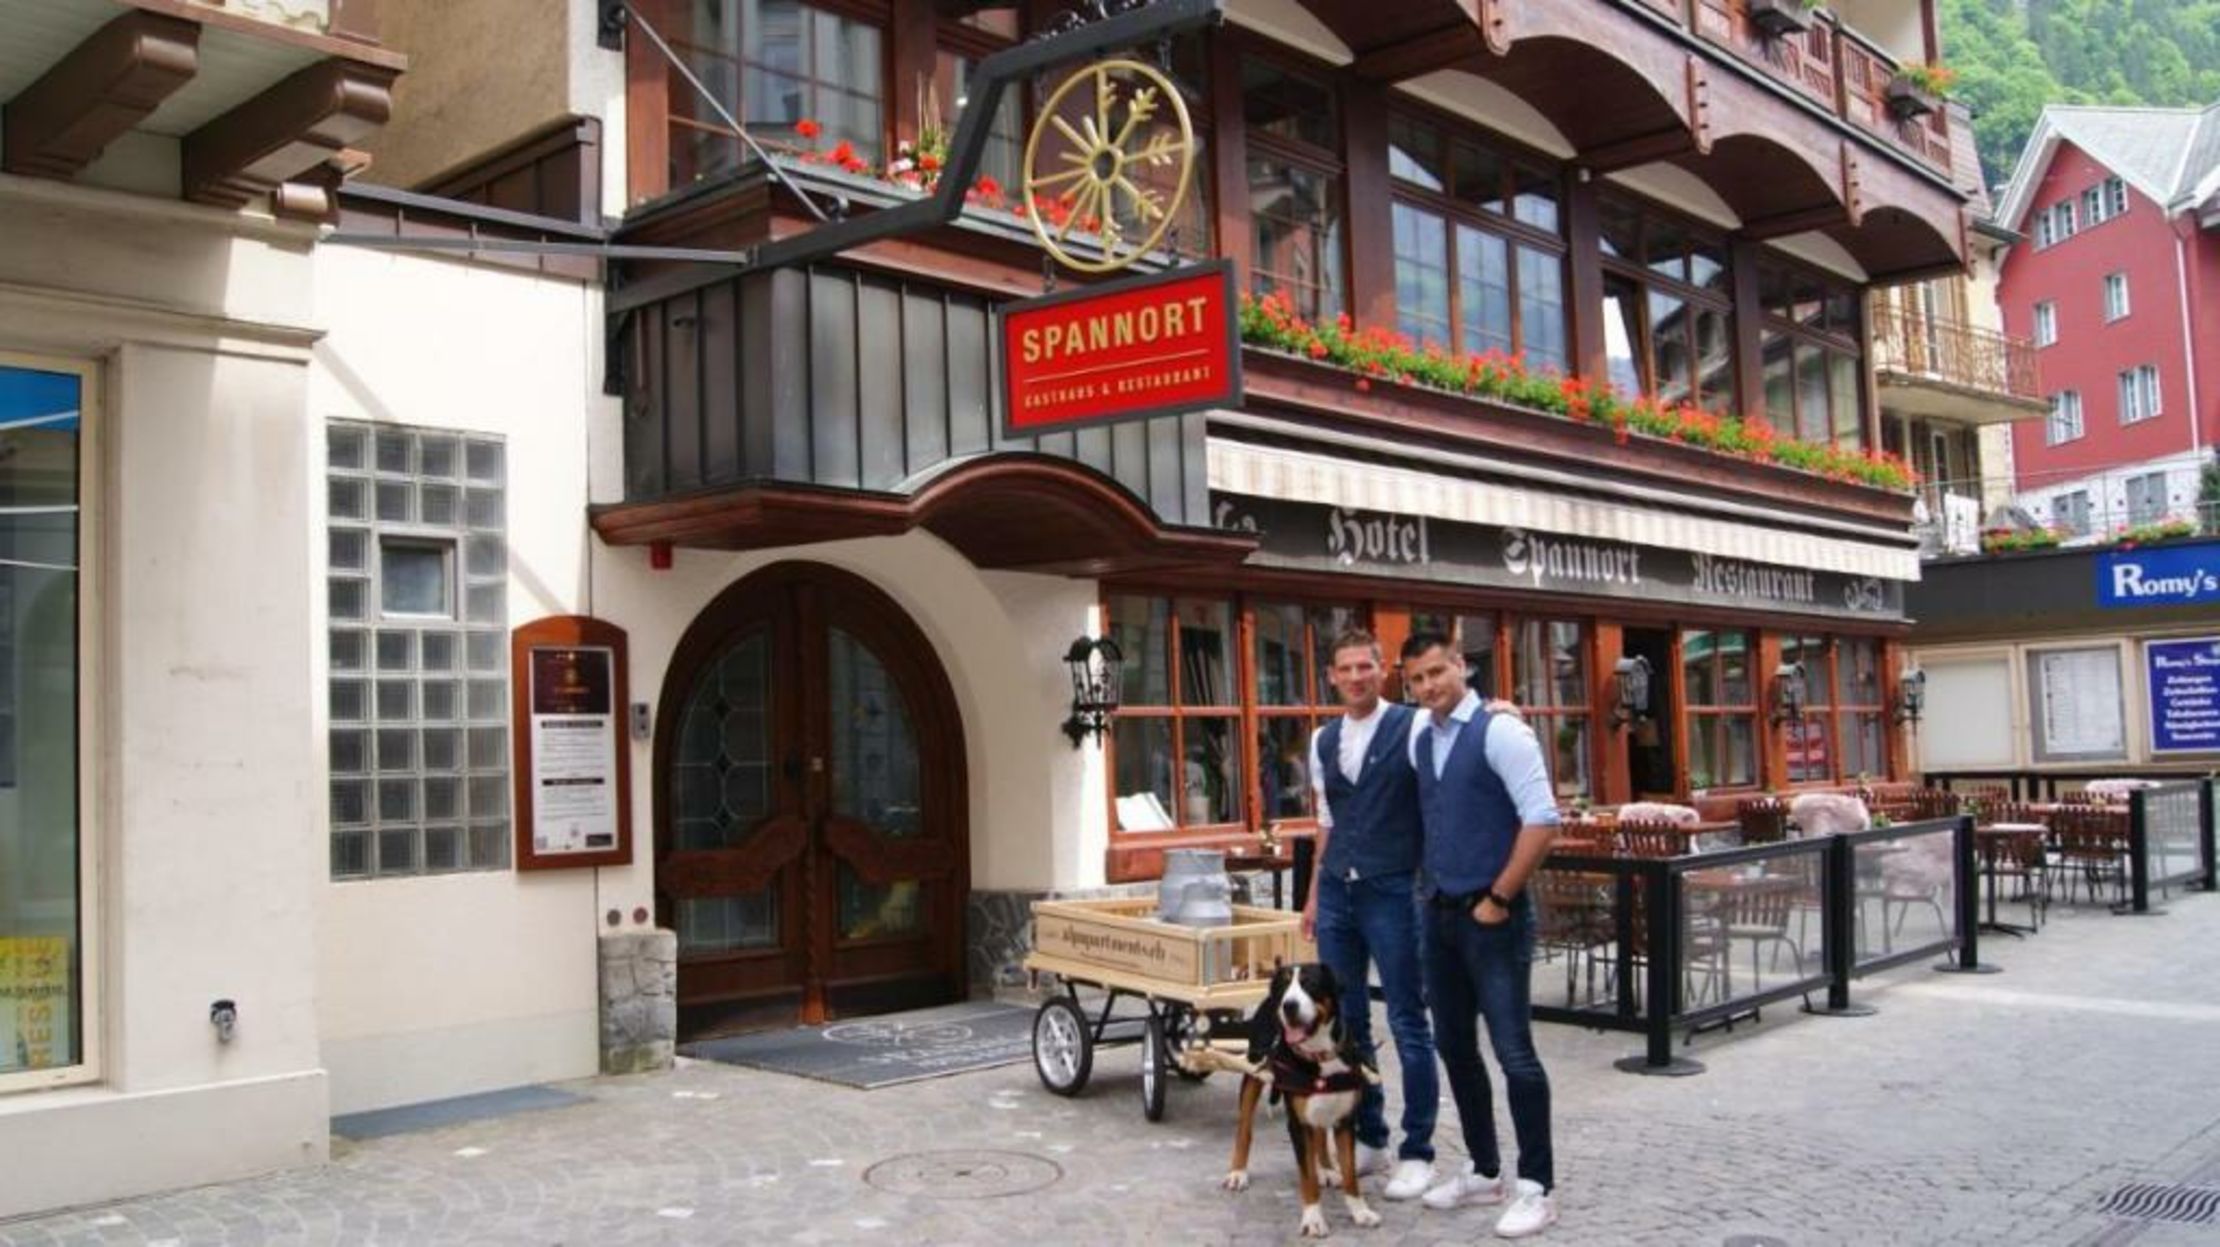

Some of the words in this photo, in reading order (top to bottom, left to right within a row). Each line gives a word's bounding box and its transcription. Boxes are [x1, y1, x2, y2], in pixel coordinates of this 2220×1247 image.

[1022, 296, 1208, 363] SPANNORT
[1024, 385, 1094, 408] GASTHAUS
[1101, 382, 1111, 396] &
[1117, 366, 1211, 393] RESTAURANT
[1328, 506, 1430, 566] Hotel
[1503, 526, 1641, 588] Spannort
[1691, 553, 1815, 602] Restaurant
[2112, 563, 2218, 598] Romy's
